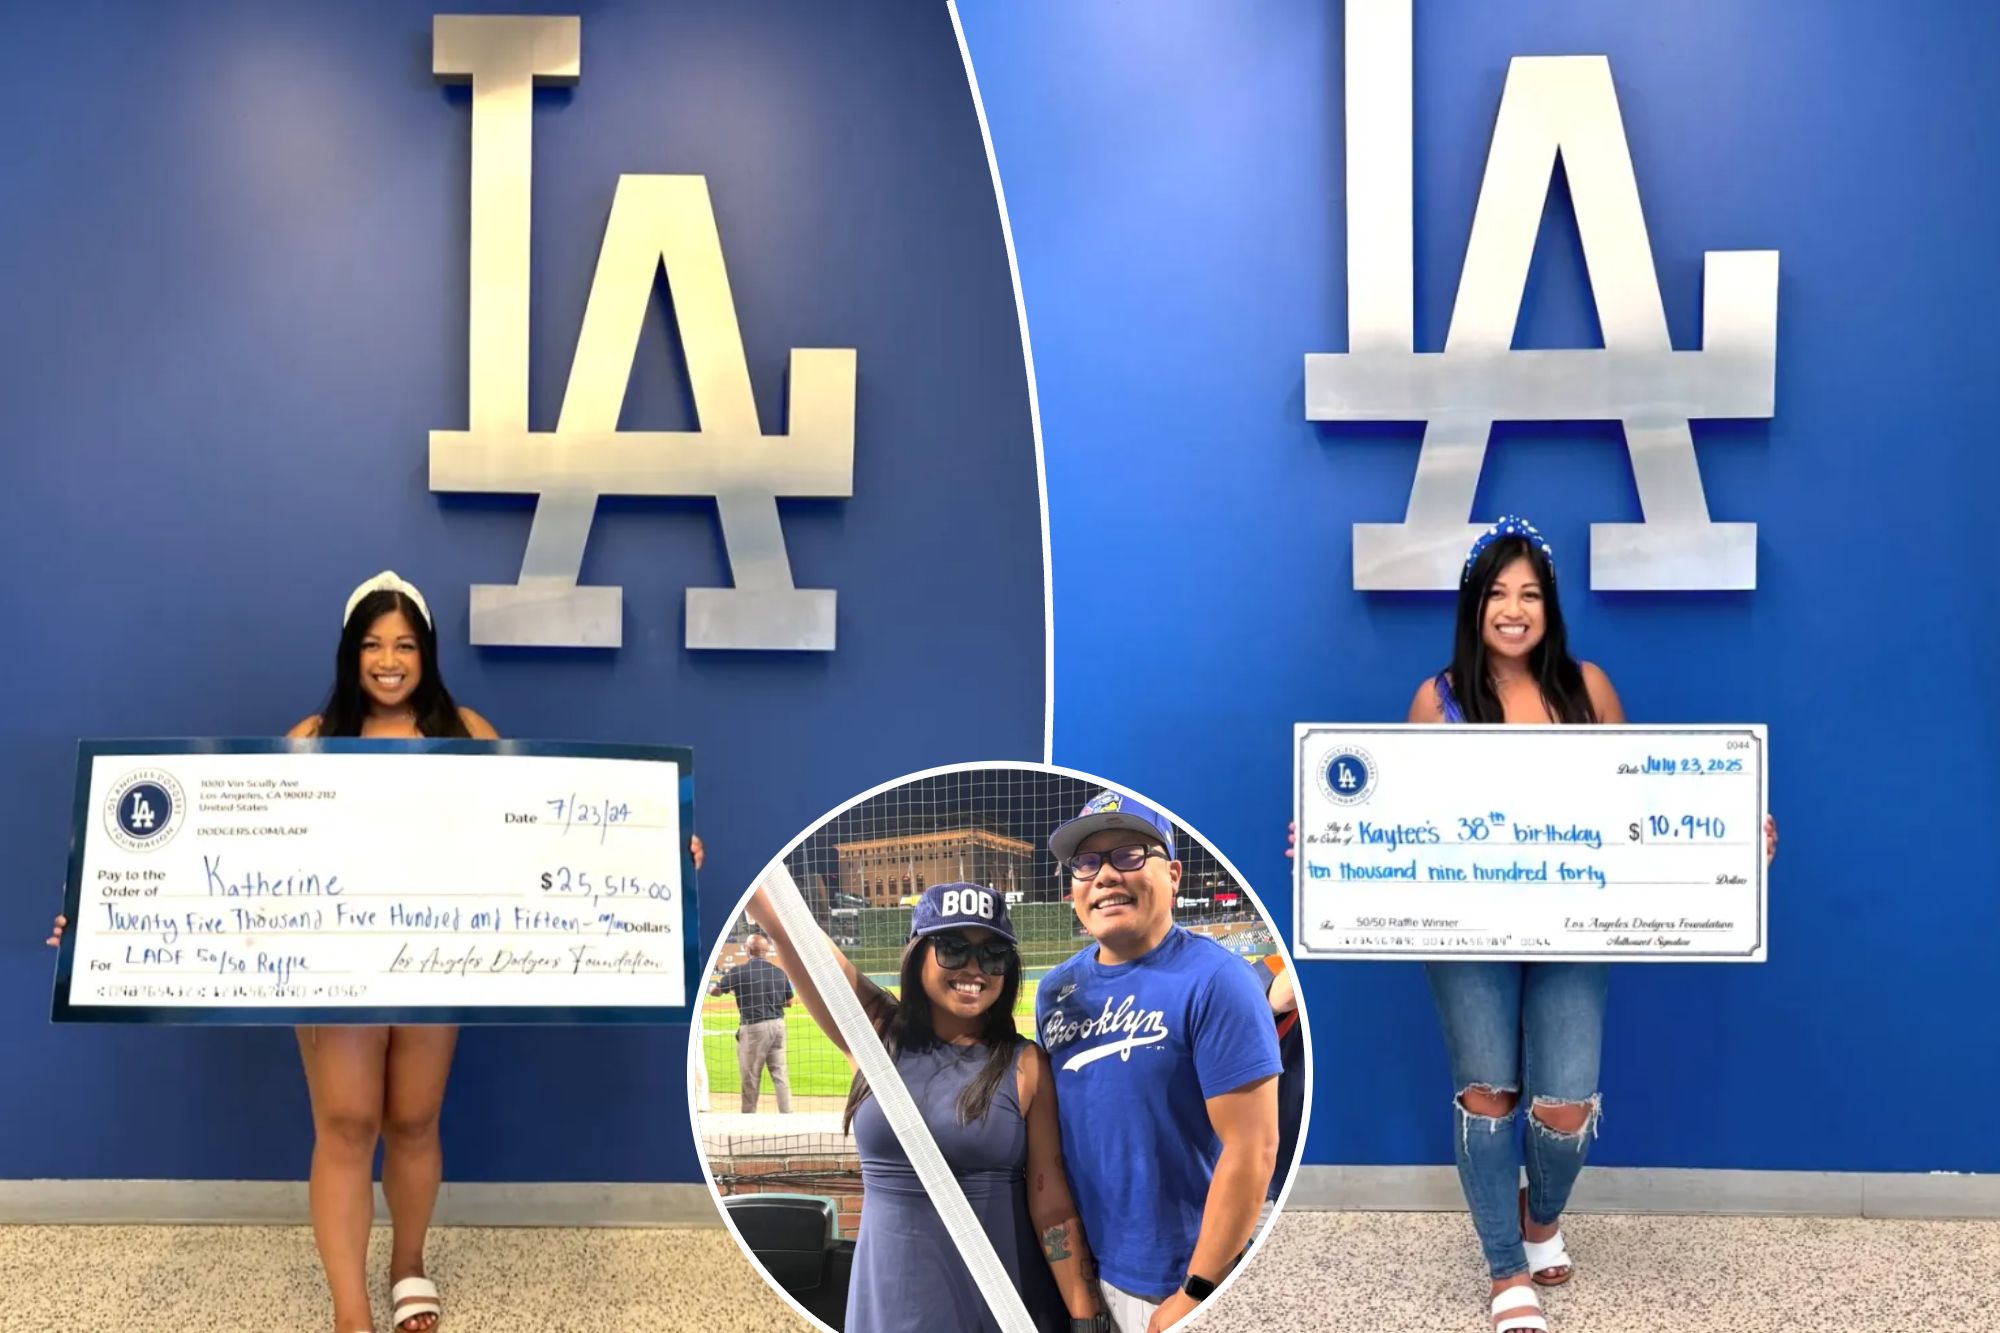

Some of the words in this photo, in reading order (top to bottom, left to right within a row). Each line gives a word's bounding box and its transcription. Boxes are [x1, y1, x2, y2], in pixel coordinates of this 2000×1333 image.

[1305, 0, 1779, 590] LA
[429, 14, 857, 650] LA
[1726, 740, 1750, 750] 0044
[1338, 762, 1357, 788] LA
[1641, 755, 1676, 776] July
[1707, 758, 1743, 773] 2025
[227, 779, 245, 788] Vin
[279, 779, 299, 788] Ave
[200, 791, 217, 801] Los
[266, 791, 282, 800] CA
[131, 792, 155, 828] LA
[198, 803, 234, 813] United
[236, 803, 269, 813] States
[505, 812, 538, 824] Date
[546, 792, 633, 846] 7/23/24
[1513, 822, 1603, 850] birthday
[1629, 822, 1641, 842] $
[97, 870, 122, 884] Pay
[124, 871, 140, 882] to
[142, 870, 166, 882] the
[204, 855, 344, 897] Katherine
[1340, 858, 1417, 881] thousand
[1428, 862, 1467, 882] nine
[1473, 860, 1548, 882] hundred
[1556, 860, 1607, 889] forty
[102, 886, 142, 898] Order
[144, 886, 159, 897] of
[942, 889, 994, 920] BOB
[100, 902, 178, 945] Twenty
[186, 912, 226, 935] Five
[231, 905, 322, 934] Thousand
[337, 903, 377, 926] Five
[390, 903, 460, 931] Hundred
[470, 907, 501, 933] and
[624, 921, 672, 934] Dollars
[1356, 917, 1386, 928] 50/50
[1388, 917, 1419, 928] Raffle
[1422, 917, 1459, 929] Winner
[1564, 917, 1584, 929] Los
[1590, 917, 1629, 931] Angeles
[1632, 917, 1676, 931] Dodgers
[1678, 917, 1734, 929] Foundation
[90, 959, 112, 972] For
[125, 945, 184, 964] LADF
[196, 948, 246, 975] 50/50
[389, 943, 412, 973] Los
[420, 945, 483, 977] Angeles
[490, 949, 561, 974] Dodgers
[569, 944, 662, 975] Foundation
[1043, 994, 1168, 1062] Brooklyn
